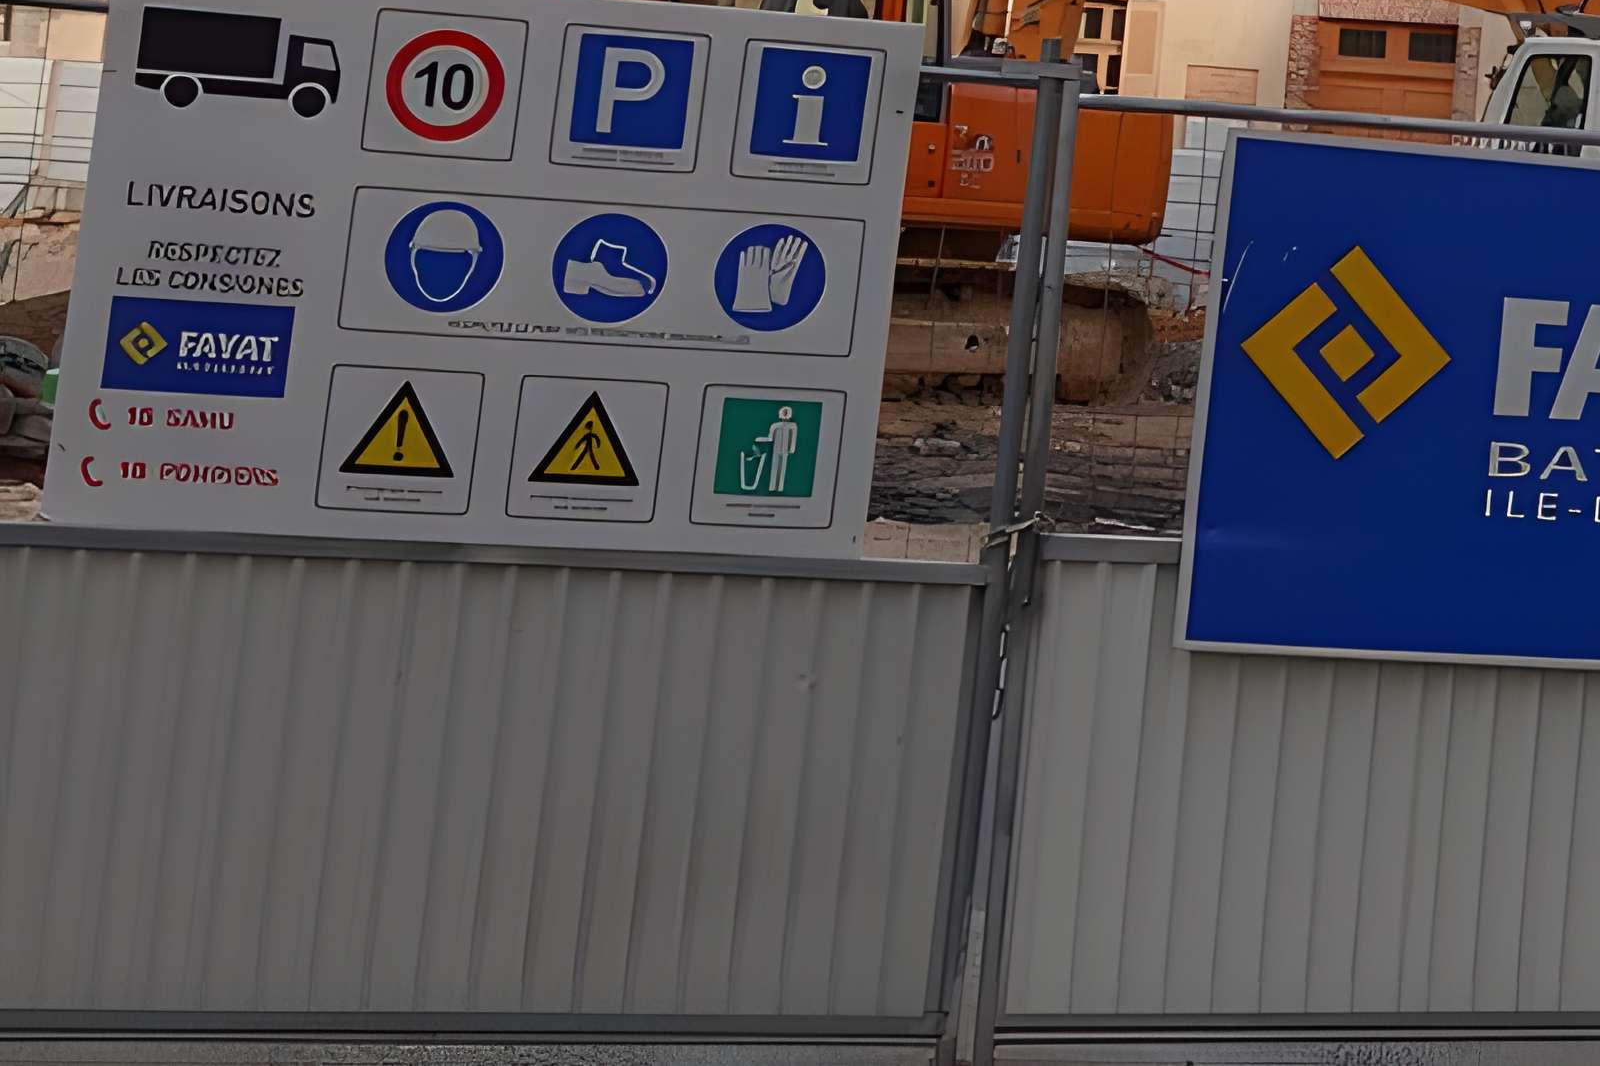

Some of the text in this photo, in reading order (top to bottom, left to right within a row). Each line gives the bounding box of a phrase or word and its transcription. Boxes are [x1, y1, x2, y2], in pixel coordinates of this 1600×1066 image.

[414, 61, 475, 111] 10
[595, 47, 666, 134] P
[127, 181, 317, 219] LIVRAISONS
[178, 330, 280, 364] FAYAT
